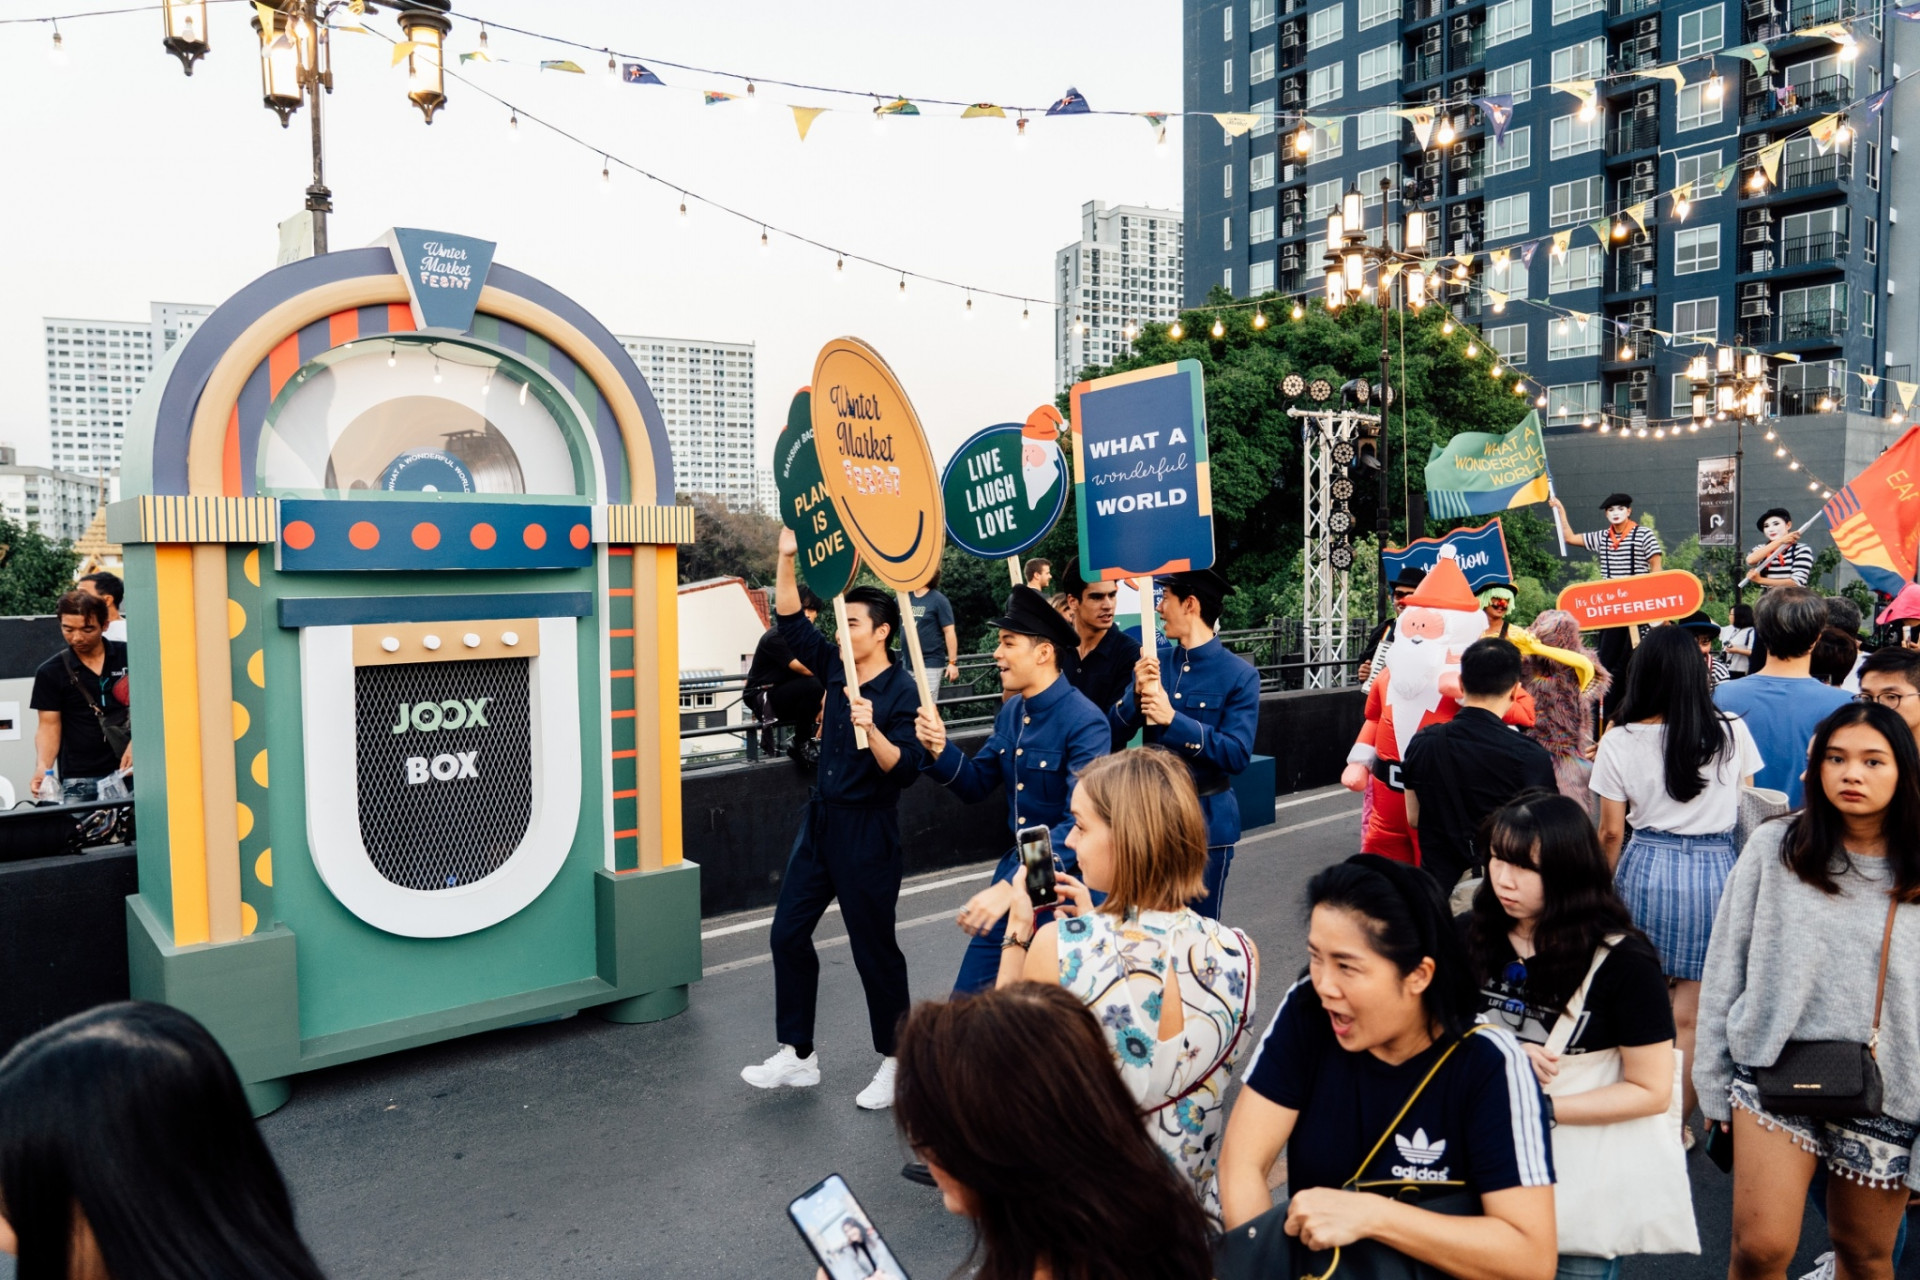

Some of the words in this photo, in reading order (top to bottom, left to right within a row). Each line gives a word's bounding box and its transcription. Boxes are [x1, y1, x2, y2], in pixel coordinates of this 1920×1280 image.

[420, 256, 471, 276] Market
[423, 241, 468, 261] Winter
[830, 384, 882, 421] Winter
[801, 428, 815, 443] BAC
[837, 421, 895, 462] Market
[1089, 431, 1159, 459] WHAT
[1168, 427, 1188, 445] A
[1484, 435, 1518, 457] WHAT
[1524, 427, 1535, 442] A
[388, 469, 400, 492] WHAT
[399, 461, 406, 470] A
[404, 453, 454, 468] WONDERFUL
[455, 466, 470, 493] WORLD
[967, 447, 1004, 482] LIVE
[1091, 452, 1188, 486] wonderful
[1455, 444, 1540, 472] WONDERFUL
[1489, 454, 1545, 487] WORLD
[965, 474, 1017, 513] LAUGH
[1096, 488, 1188, 517] WORLD
[812, 510, 828, 535] IS
[975, 505, 1018, 540] LOVE
[808, 529, 845, 568] LOVE
[1586, 594, 1684, 618] DIFFERENT!
[1590, 593, 1605, 604] OK
[1617, 588, 1629, 598] be
[392, 697, 490, 735] JOOX
[406, 751, 479, 785] BOX
[1391, 1165, 1448, 1181] adidas
